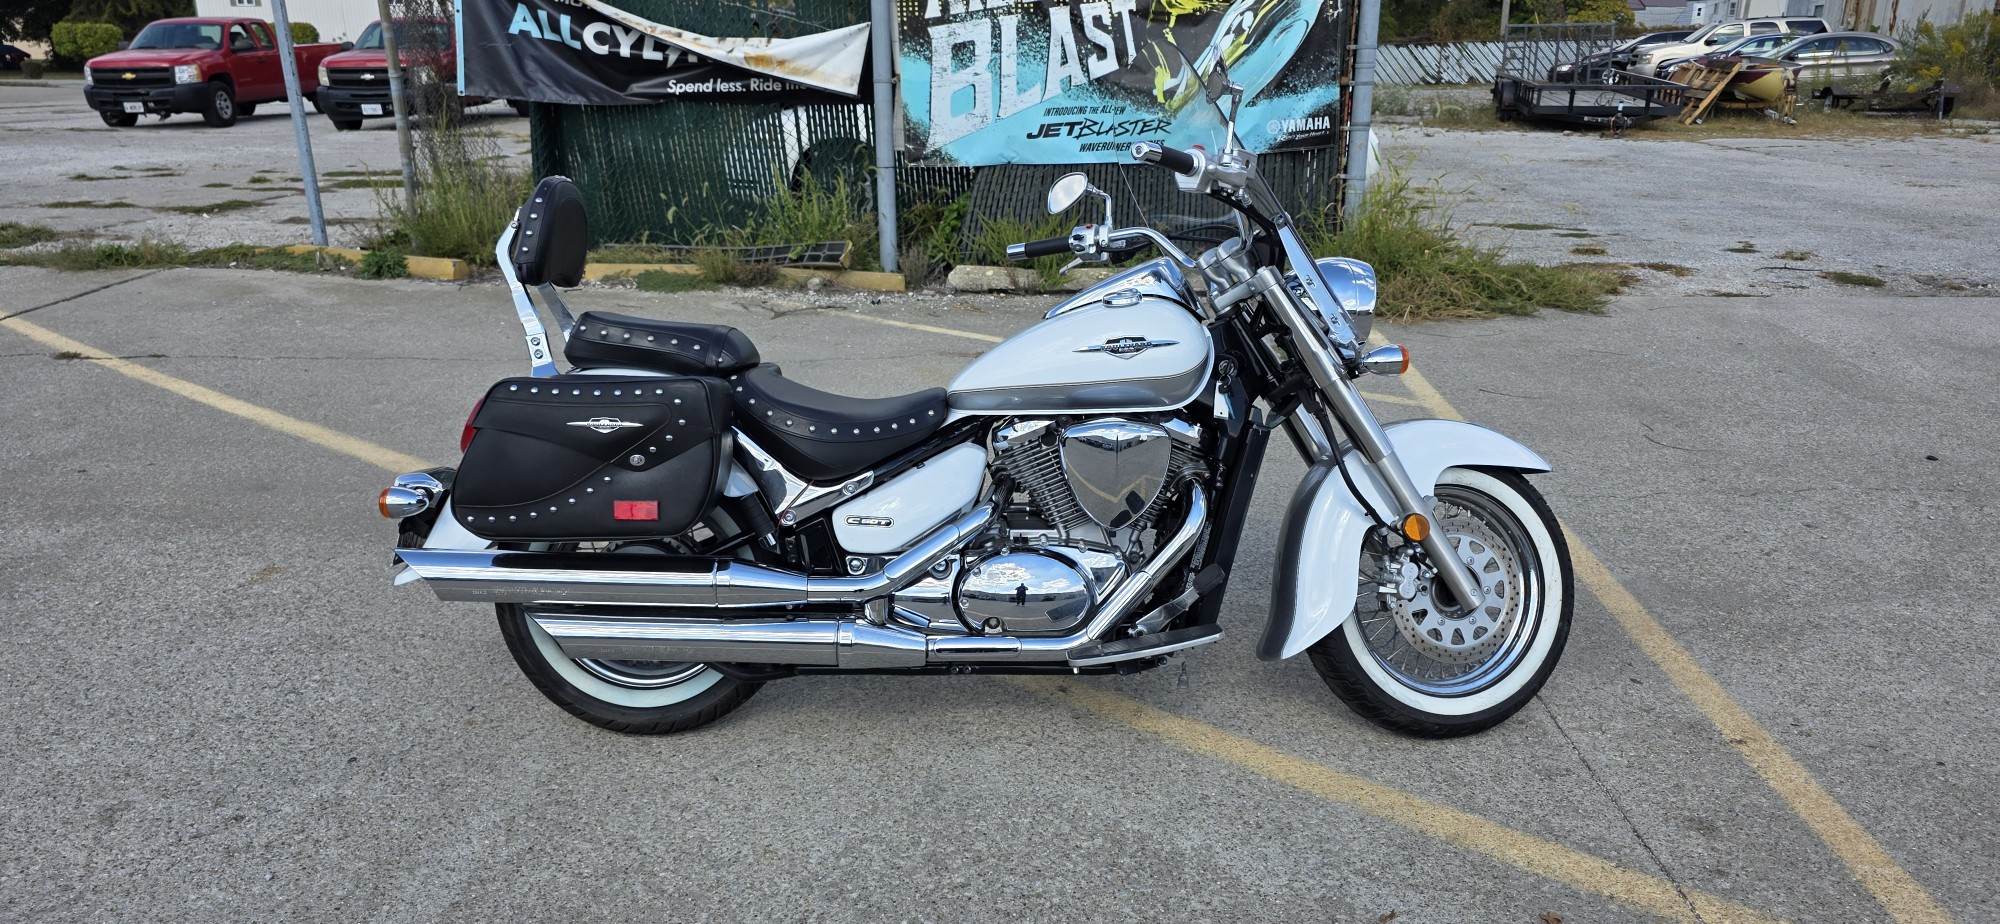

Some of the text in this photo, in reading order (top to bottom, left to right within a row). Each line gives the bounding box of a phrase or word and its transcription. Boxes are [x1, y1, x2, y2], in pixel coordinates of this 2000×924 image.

[927, 0, 1137, 150] BLAST
[667, 78, 713, 95] Spend
[716, 78, 746, 92] less.
[750, 78, 782, 91] Ride
[1043, 106, 1088, 117] INTRODUCING
[1089, 106, 1100, 115] THE
[1281, 116, 1330, 132] YAMAHA
